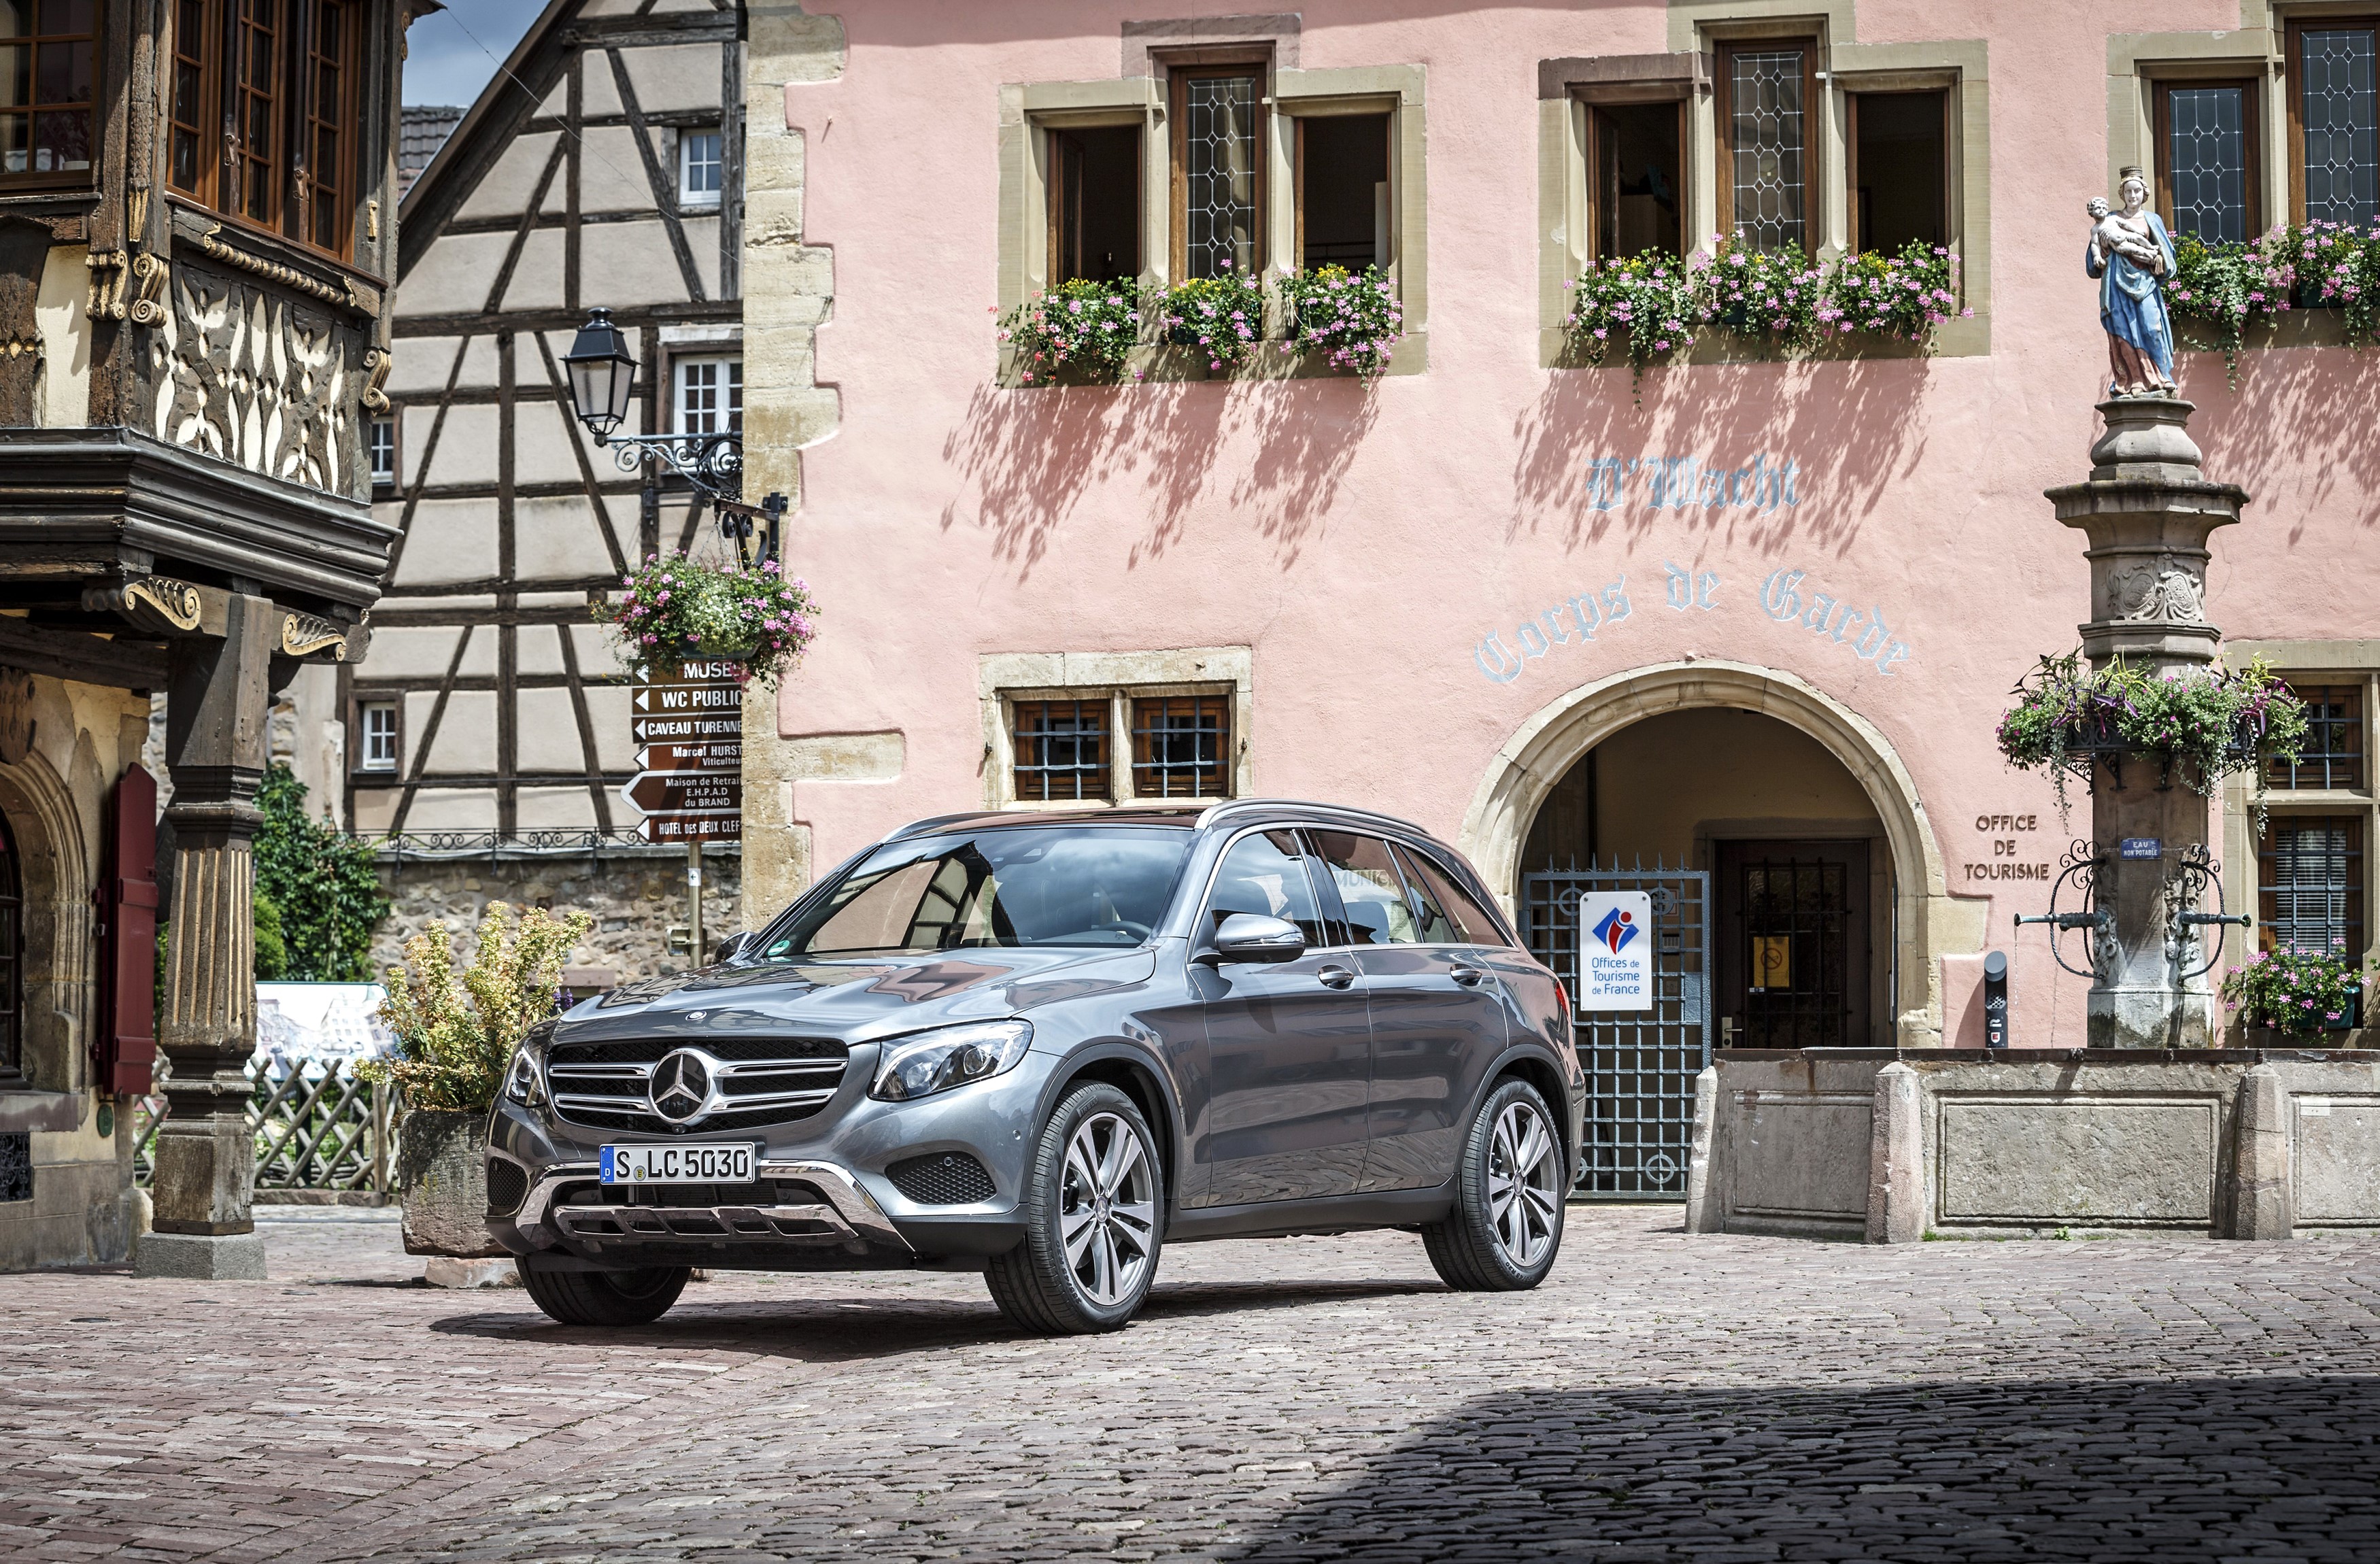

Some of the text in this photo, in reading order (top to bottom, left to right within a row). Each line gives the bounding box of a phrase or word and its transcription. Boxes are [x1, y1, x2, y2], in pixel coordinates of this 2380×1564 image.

[1473, 559, 1909, 683] Corps de Garde
[661, 690, 687, 708] WC
[648, 721, 692, 736] CAVEAU
[673, 745, 741, 758] Marcel HURST
[702, 757, 741, 766] Viticulteu
[666, 776, 741, 787] Maison de Retrai
[685, 798, 730, 807] du BRAND
[659, 820, 741, 835] HOTEL DES DEUX CLEF
[1975, 815, 2037, 832] OFFICE
[1994, 840, 2016, 856] DE
[1964, 864, 2050, 881] TOURISME
[1592, 957, 1639, 968] Offices de
[1592, 970, 1639, 981] Tourisme
[1592, 983, 1640, 995] de France
[616, 1149, 749, 1178] S LC 5030
[605, 1168, 611, 1176] D
